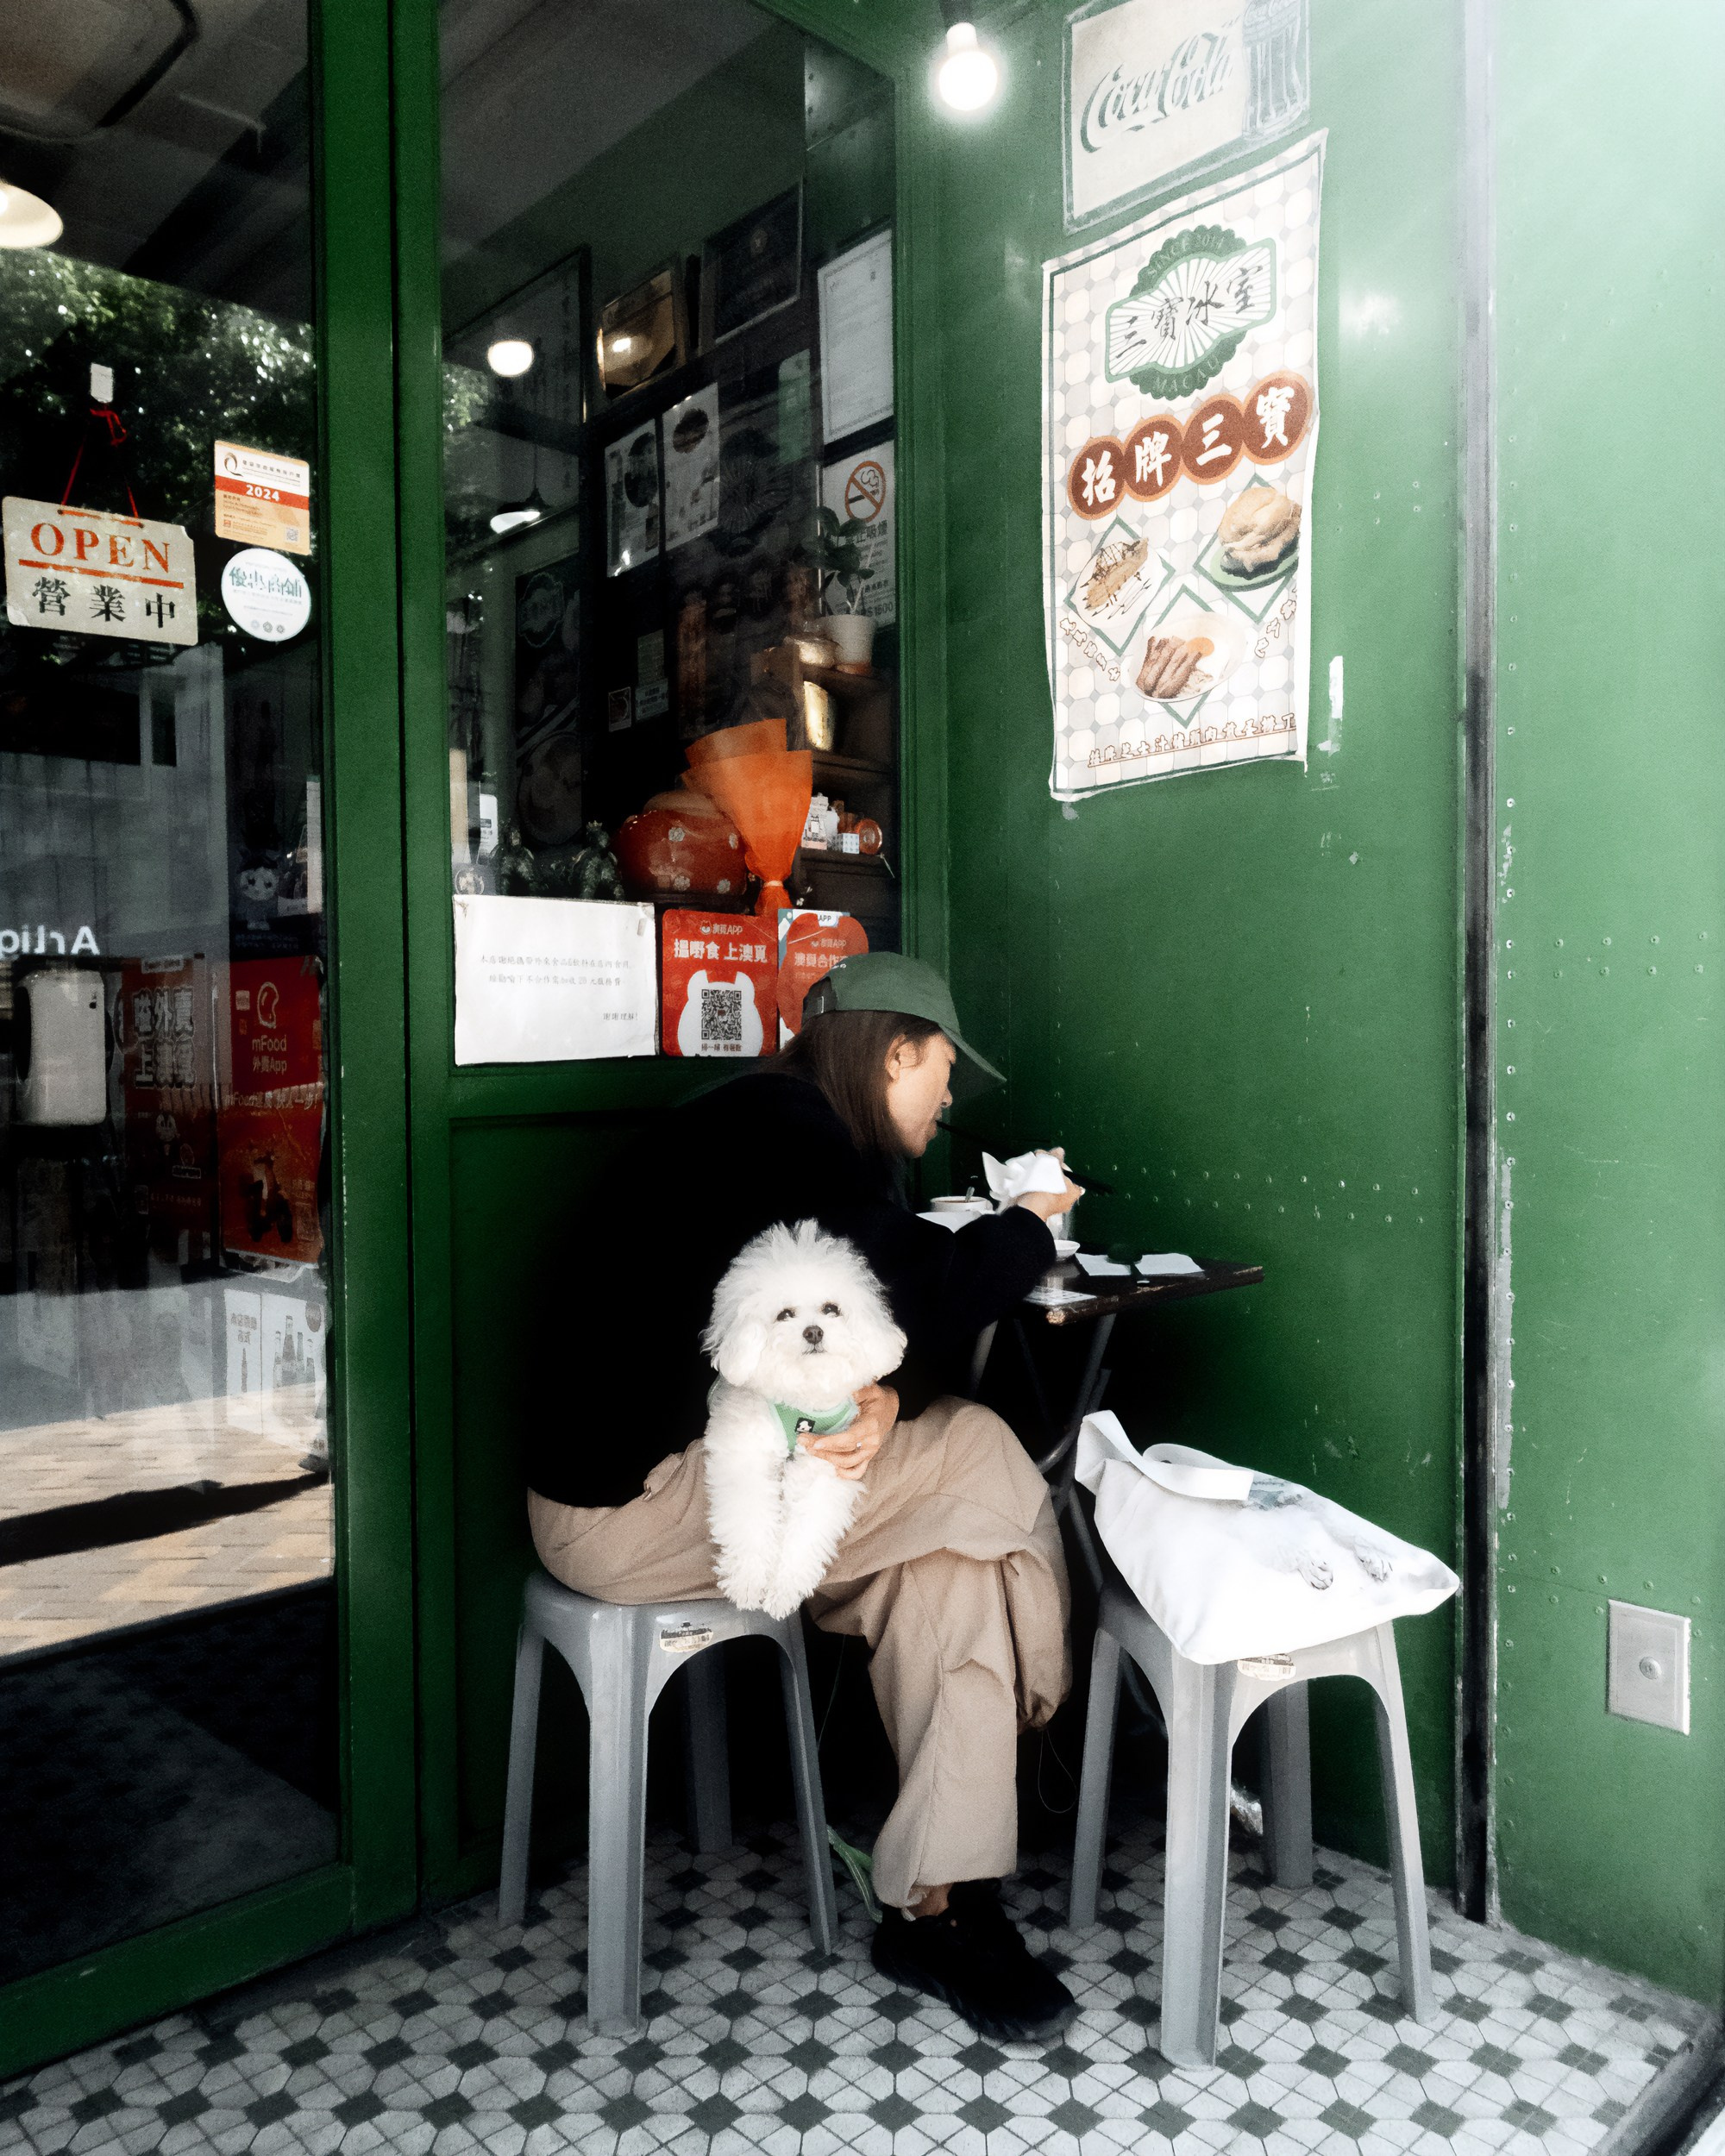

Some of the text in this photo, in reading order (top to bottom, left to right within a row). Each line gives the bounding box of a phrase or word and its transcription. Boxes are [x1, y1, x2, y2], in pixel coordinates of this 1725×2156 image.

[1116, 265, 1264, 359] 三寶冰室
[1153, 355, 1220, 394] MACAU
[1082, 385, 1295, 507] 招牌三寶
[246, 484, 280, 502] 2024
[30, 522, 171, 574] OPEN
[32, 576, 176, 629] 營業中
[252, 1034, 287, 1052] mFood
[252, 1056, 287, 1075] 外賣App
